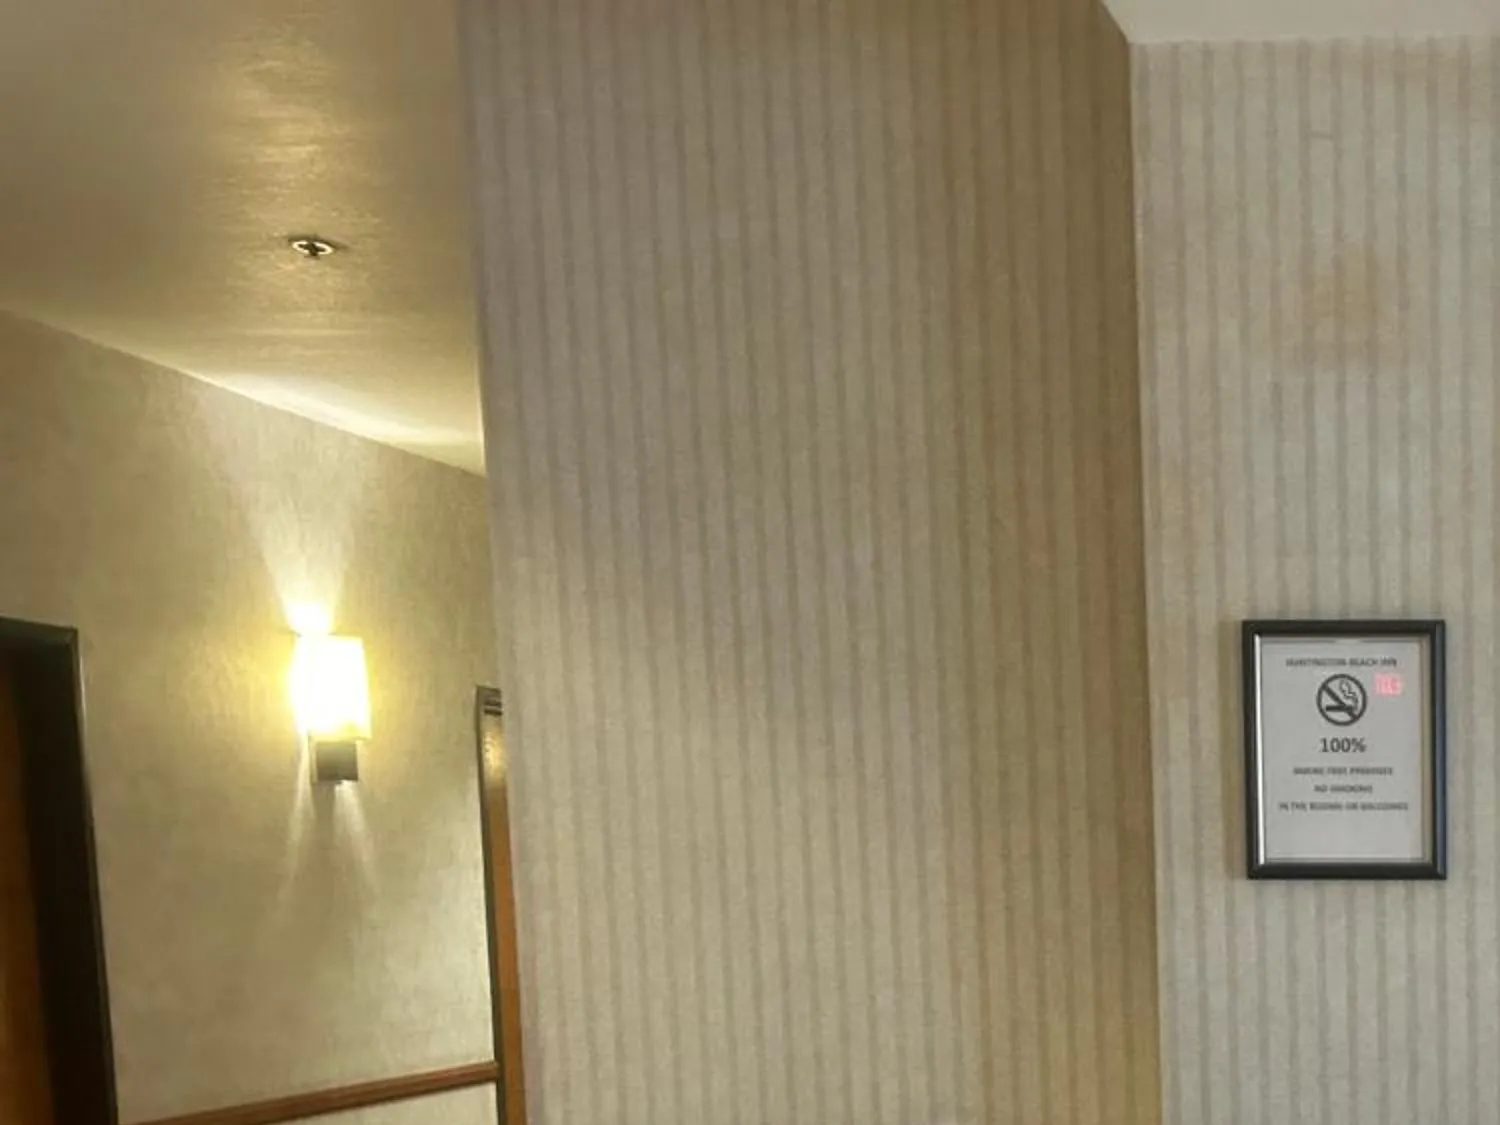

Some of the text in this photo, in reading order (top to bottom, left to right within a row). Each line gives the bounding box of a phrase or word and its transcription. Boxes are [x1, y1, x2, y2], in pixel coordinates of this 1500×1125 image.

[1319, 737, 1366, 753] 100%
[1314, 784, 1373, 794] NO SMOKING
